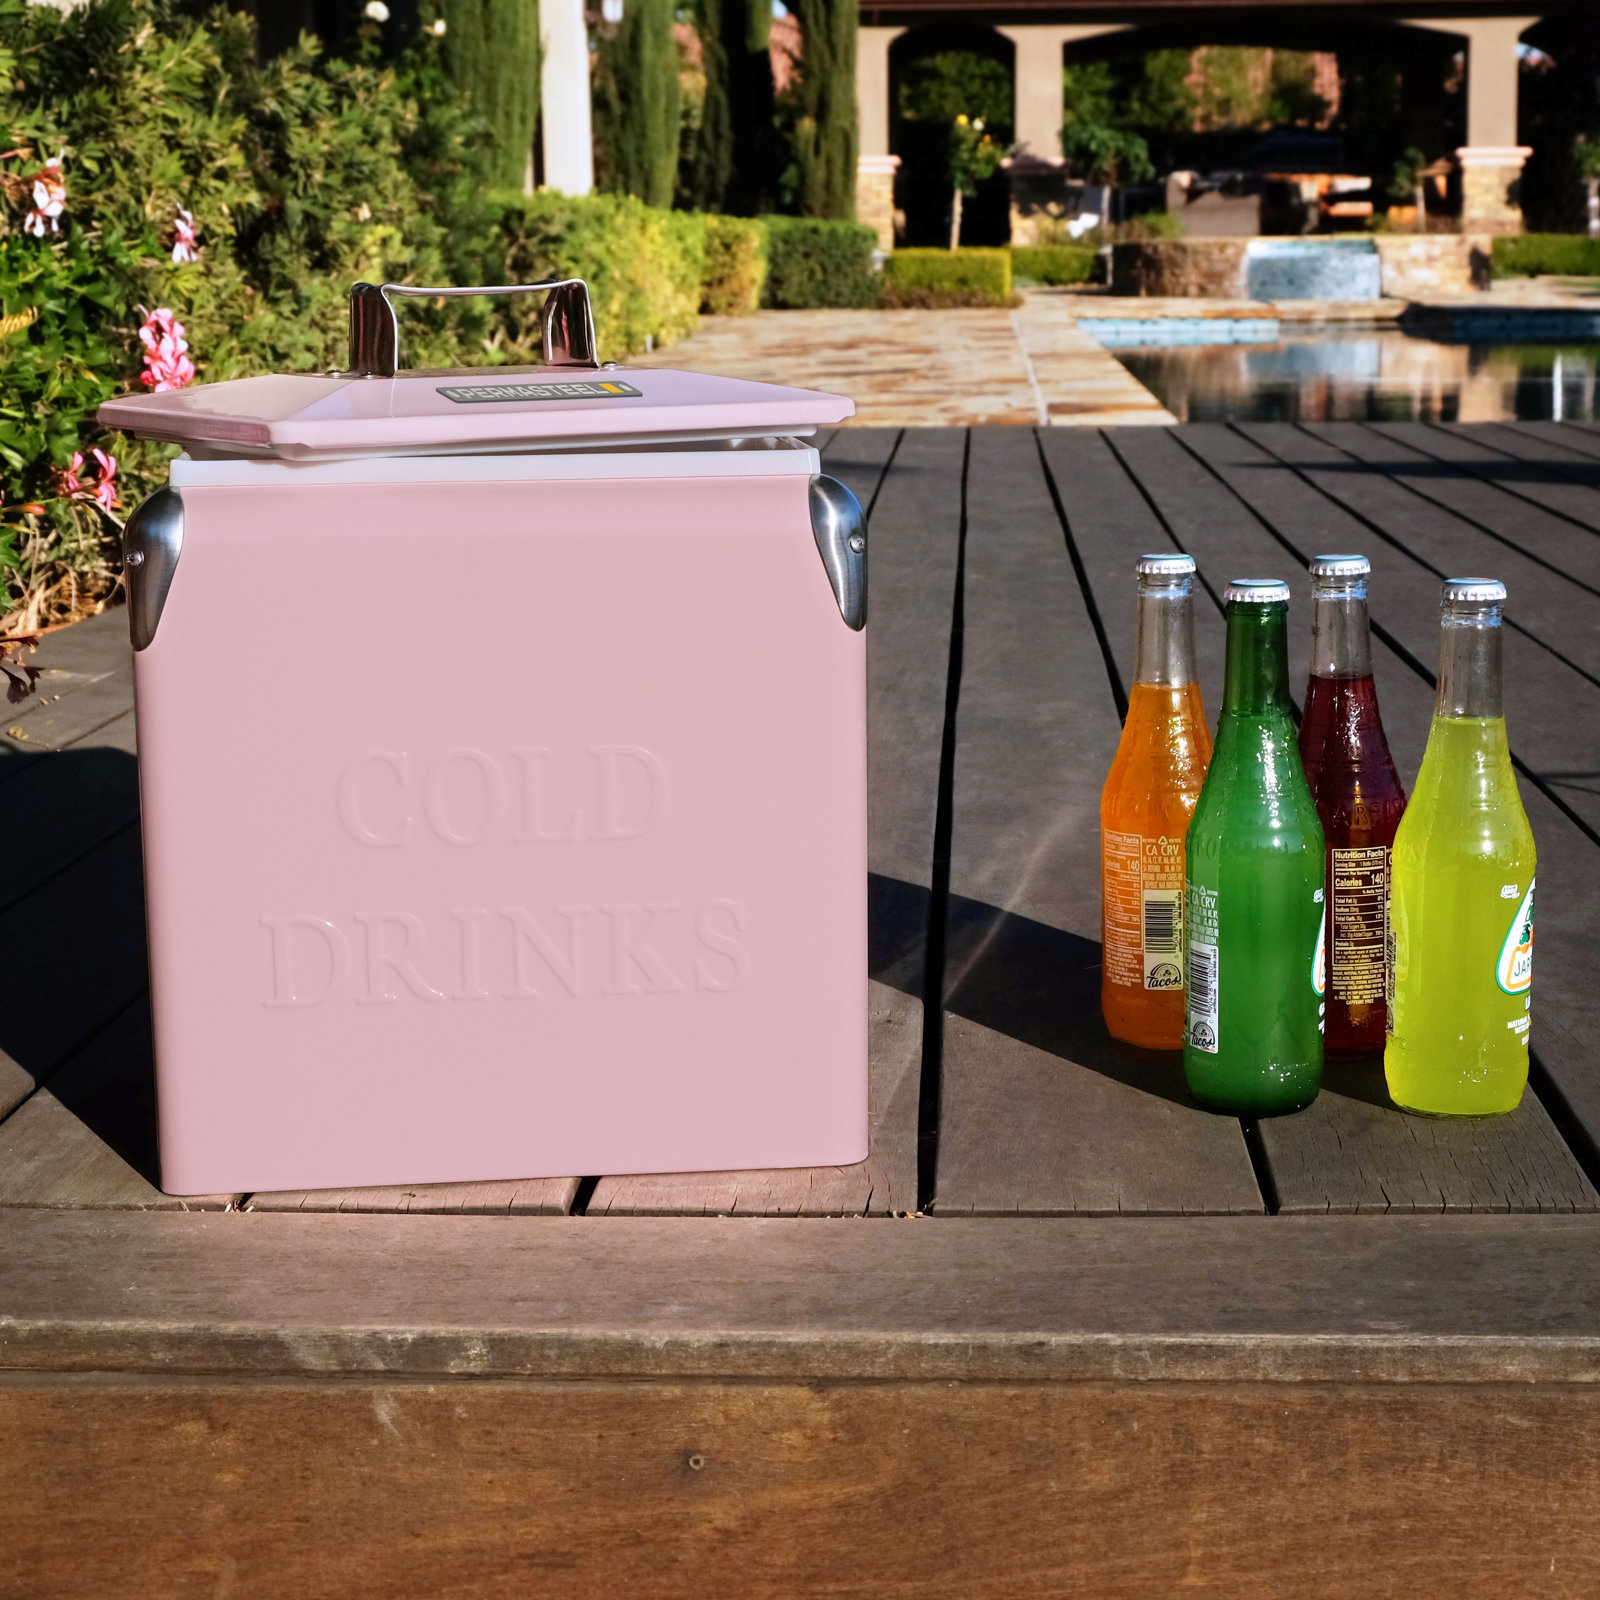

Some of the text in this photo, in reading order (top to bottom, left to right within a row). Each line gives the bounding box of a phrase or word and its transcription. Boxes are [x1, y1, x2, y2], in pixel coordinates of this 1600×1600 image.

[455, 383, 610, 399] PERMASTEEL
[336, 744, 671, 849] COLD
[1146, 845, 1158, 856] CA
[1161, 845, 1180, 856] CRV
[1335, 850, 1366, 859] Nutrition
[1366, 849, 1384, 858] Facts
[1127, 860, 1140, 872] 140
[1335, 877, 1363, 887] Calories
[1371, 872, 1384, 885] 140
[1192, 892, 1216, 909] CA CRV
[259, 899, 749, 1010] DRINKS
[1146, 975, 1181, 988] Tacos
